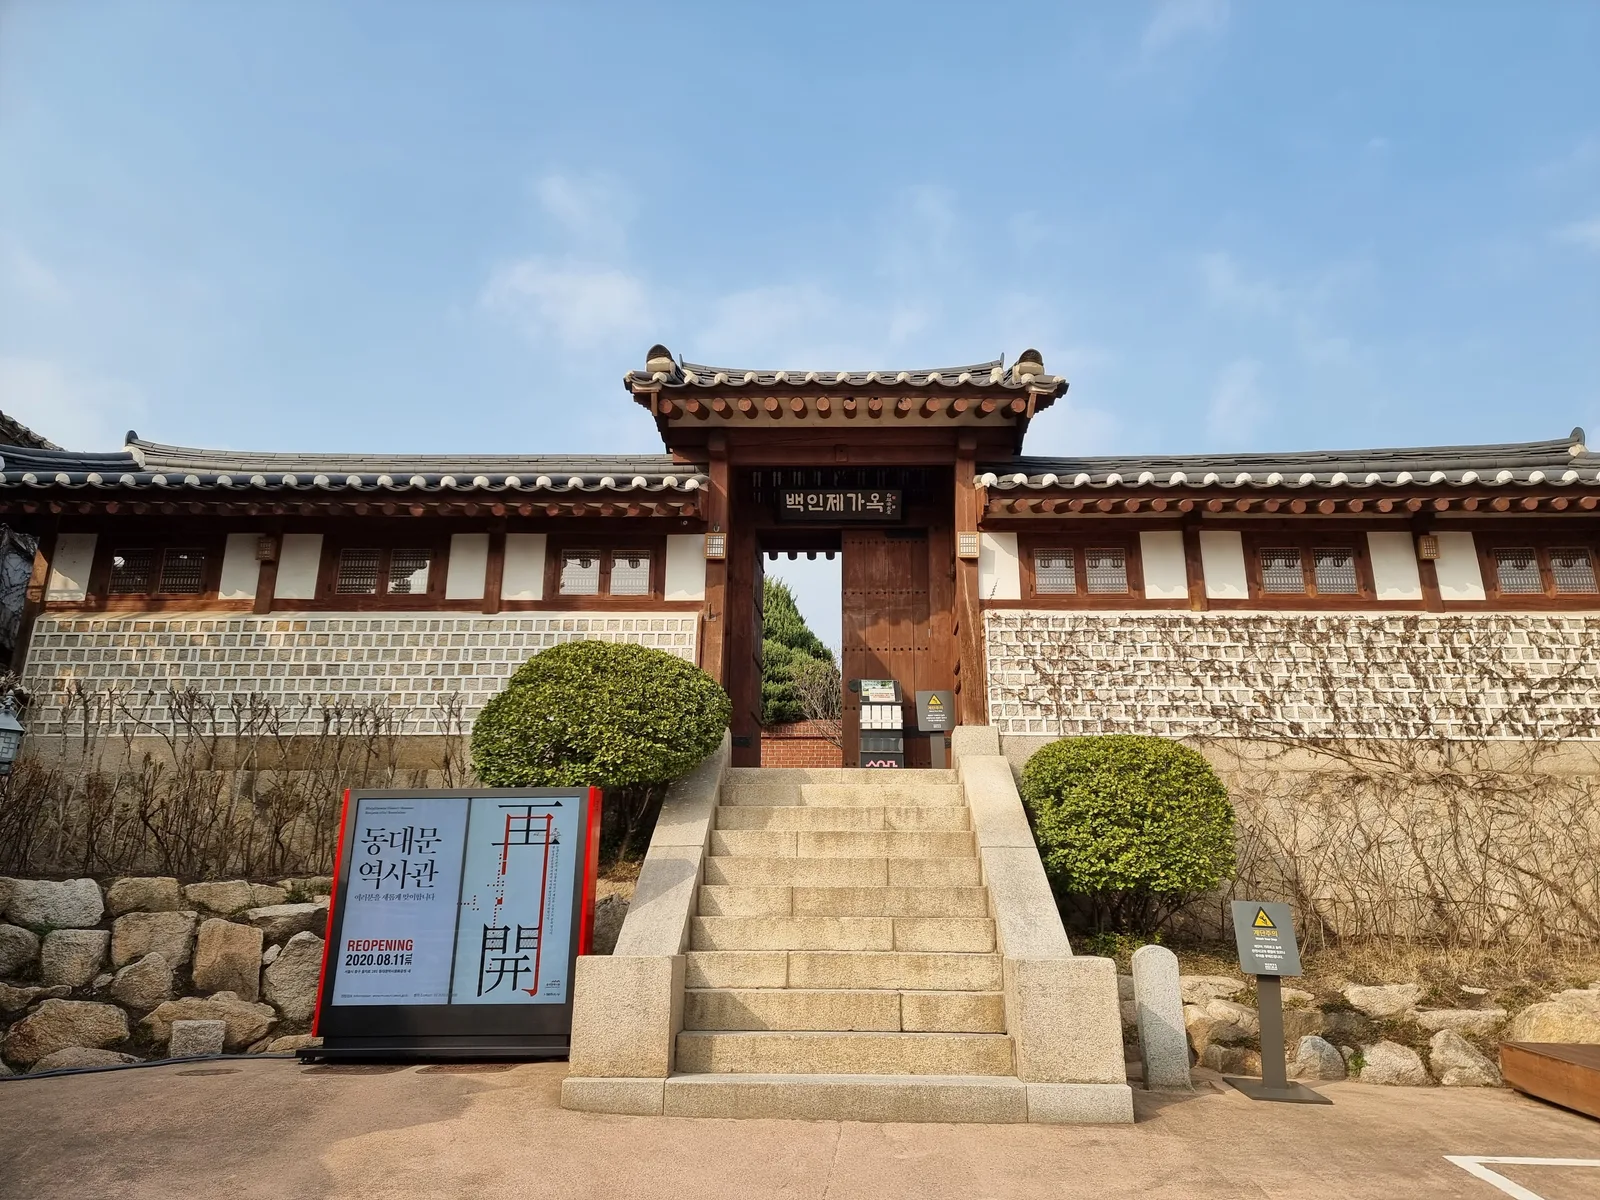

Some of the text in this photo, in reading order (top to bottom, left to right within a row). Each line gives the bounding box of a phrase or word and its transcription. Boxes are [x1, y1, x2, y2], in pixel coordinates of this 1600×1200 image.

[786, 493, 884, 512] 백인제가옥
[361, 825, 442, 856] 동대문
[359, 859, 439, 890] 역사관
[347, 939, 414, 952] REOPENING
[345, 953, 413, 966] 2020.08.11 TUE
